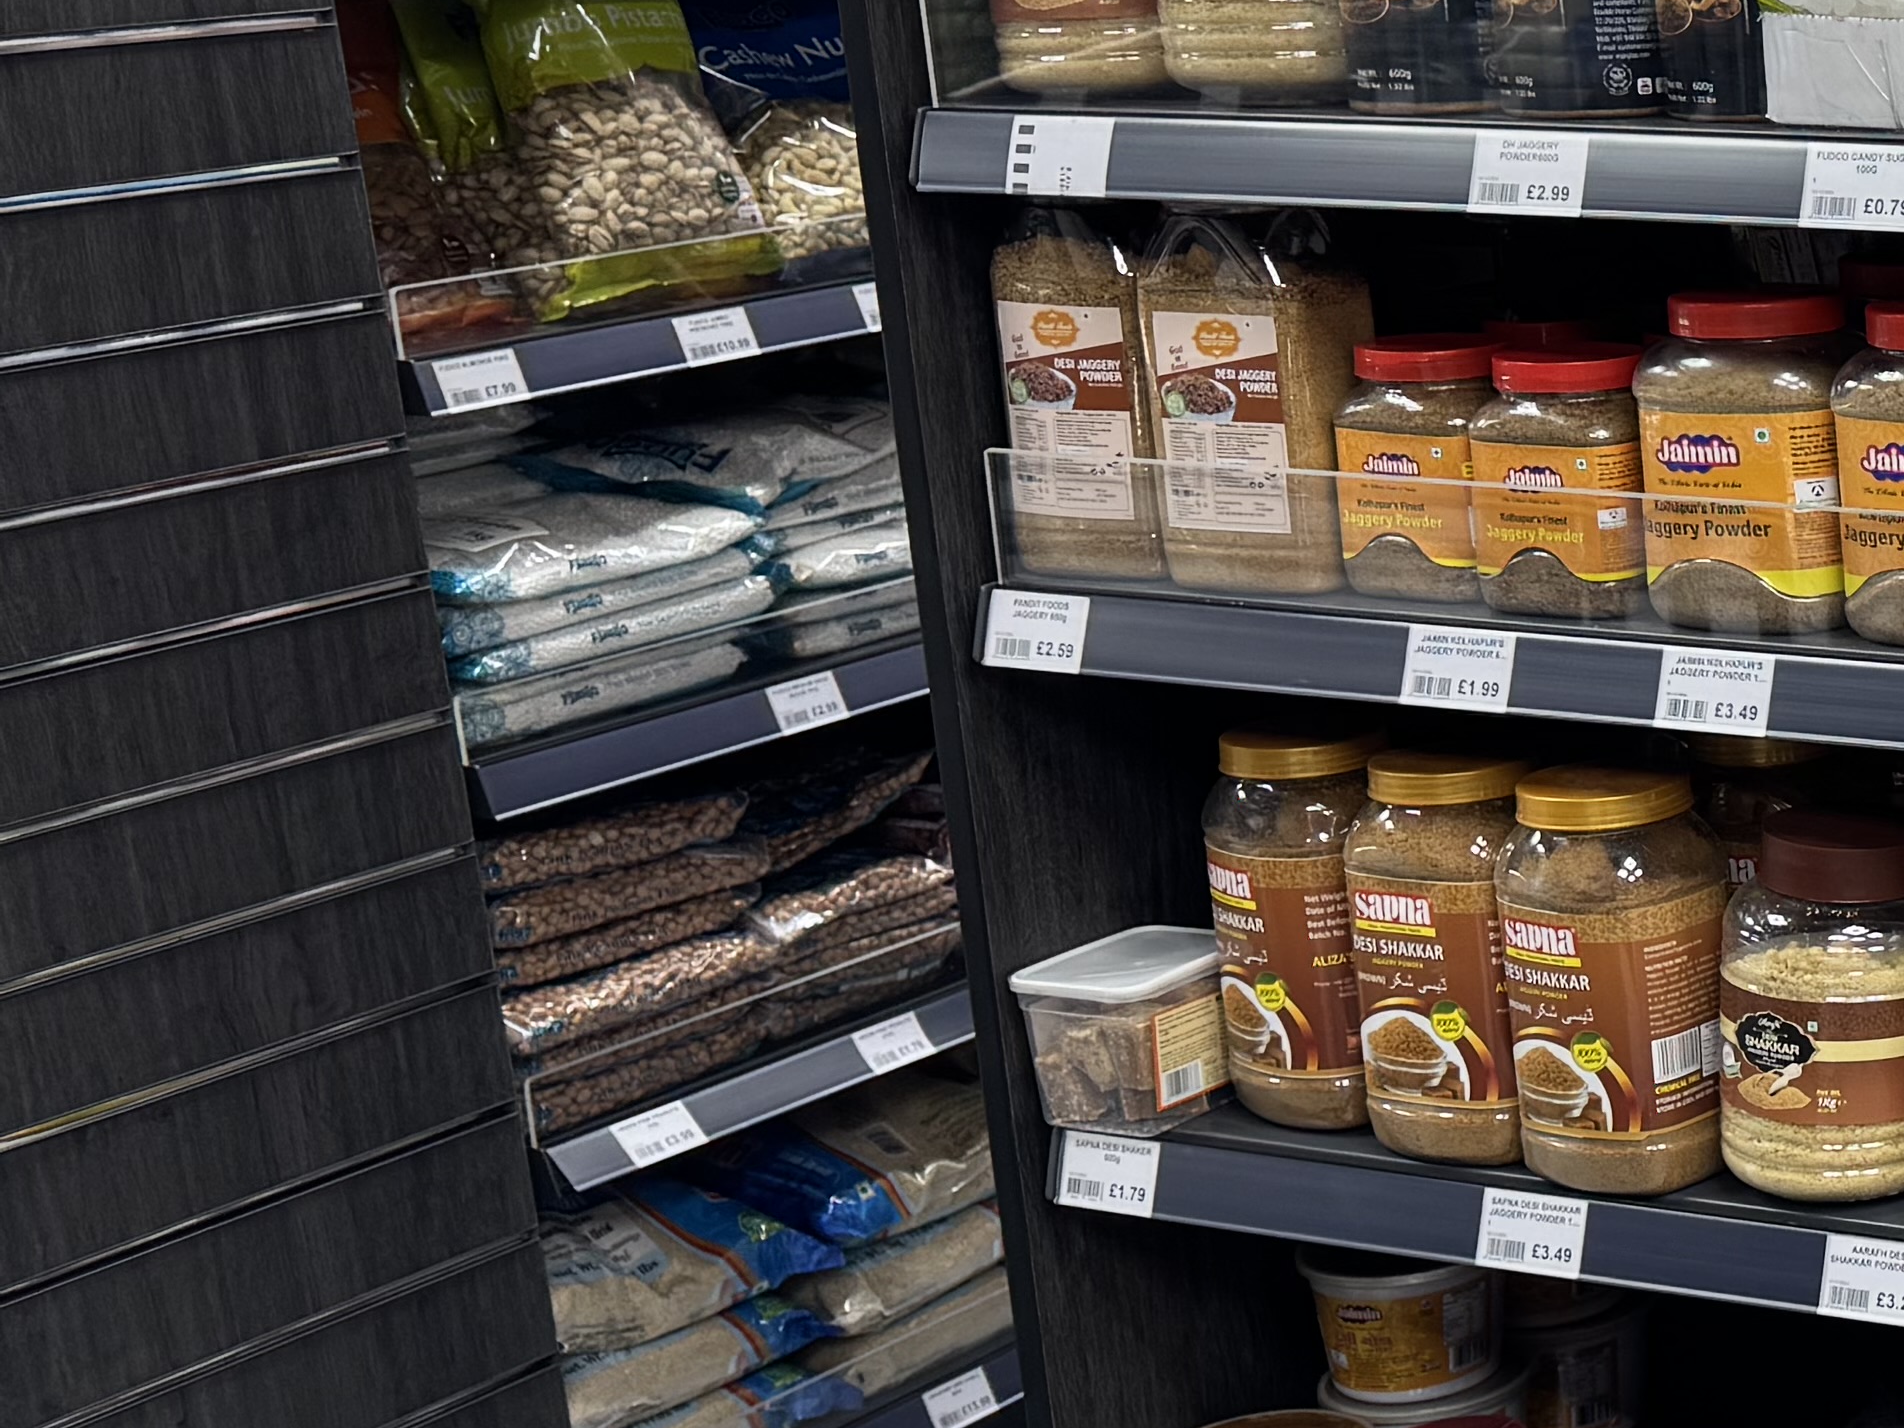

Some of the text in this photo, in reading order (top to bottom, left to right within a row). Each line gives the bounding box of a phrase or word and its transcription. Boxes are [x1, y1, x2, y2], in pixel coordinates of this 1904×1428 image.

[1817, 152, 1848, 162] FUDCO
[1851, 152, 1883, 163] CANDY
[1527, 185, 1570, 202] £2.99
[1656, 438, 1740, 467] Jaimin
[1704, 520, 1771, 539] Powder
[1036, 641, 1074, 660] £2.59
[1457, 677, 1499, 698] £1.99
[1714, 702, 1758, 722] £3.49
[1354, 935, 1445, 962] DESI SHAKKAR
[1526, 967, 1591, 992] SHAKKAR
[1109, 1183, 1146, 1202] £1.79
[1531, 1243, 1572, 1264] £3.49
